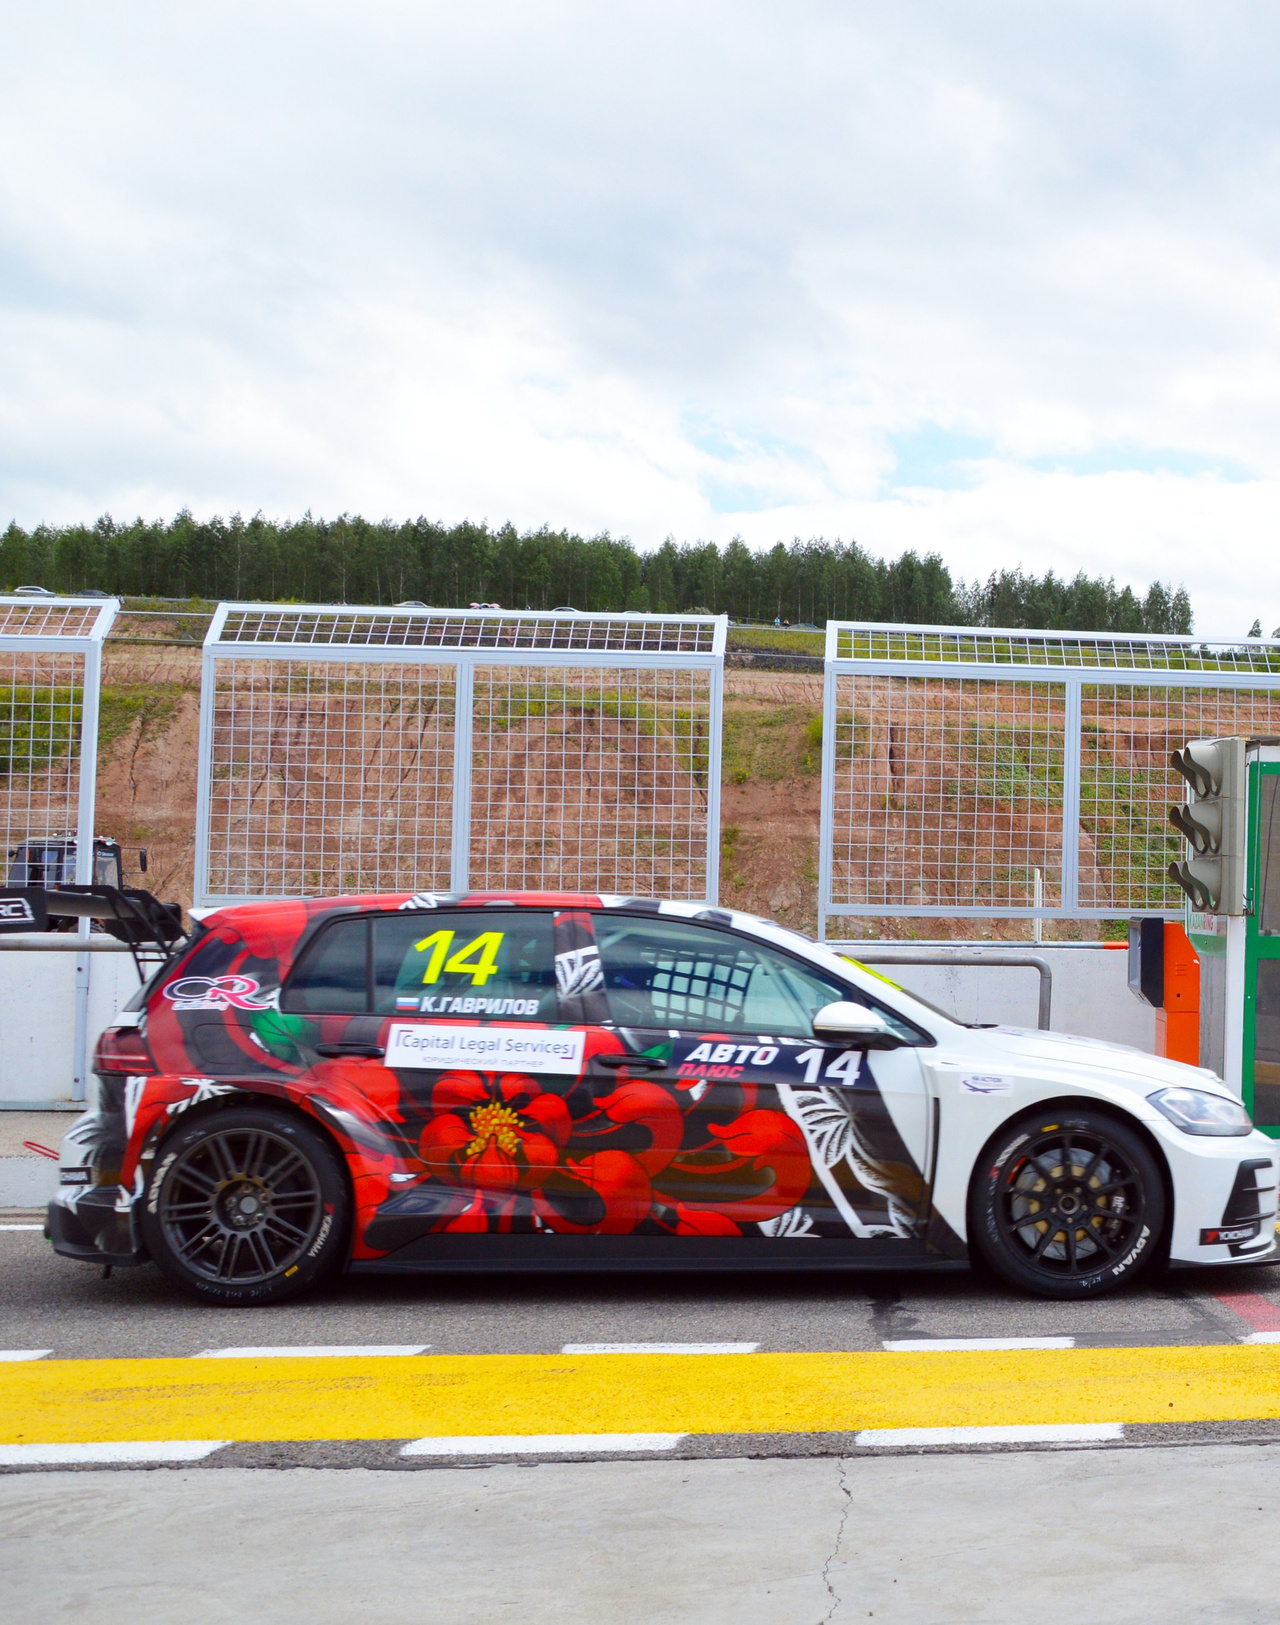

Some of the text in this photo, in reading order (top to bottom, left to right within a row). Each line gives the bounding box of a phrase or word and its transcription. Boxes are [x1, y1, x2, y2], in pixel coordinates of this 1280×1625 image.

[414, 929, 505, 986] 14
[401, 1034, 570, 1055] Capital Legal Services
[684, 1042, 780, 1066] АВТО
[676, 1062, 746, 1079] ПЛЮС
[795, 1047, 863, 1086] 14
[1112, 1224, 1151, 1276] ADVAN
